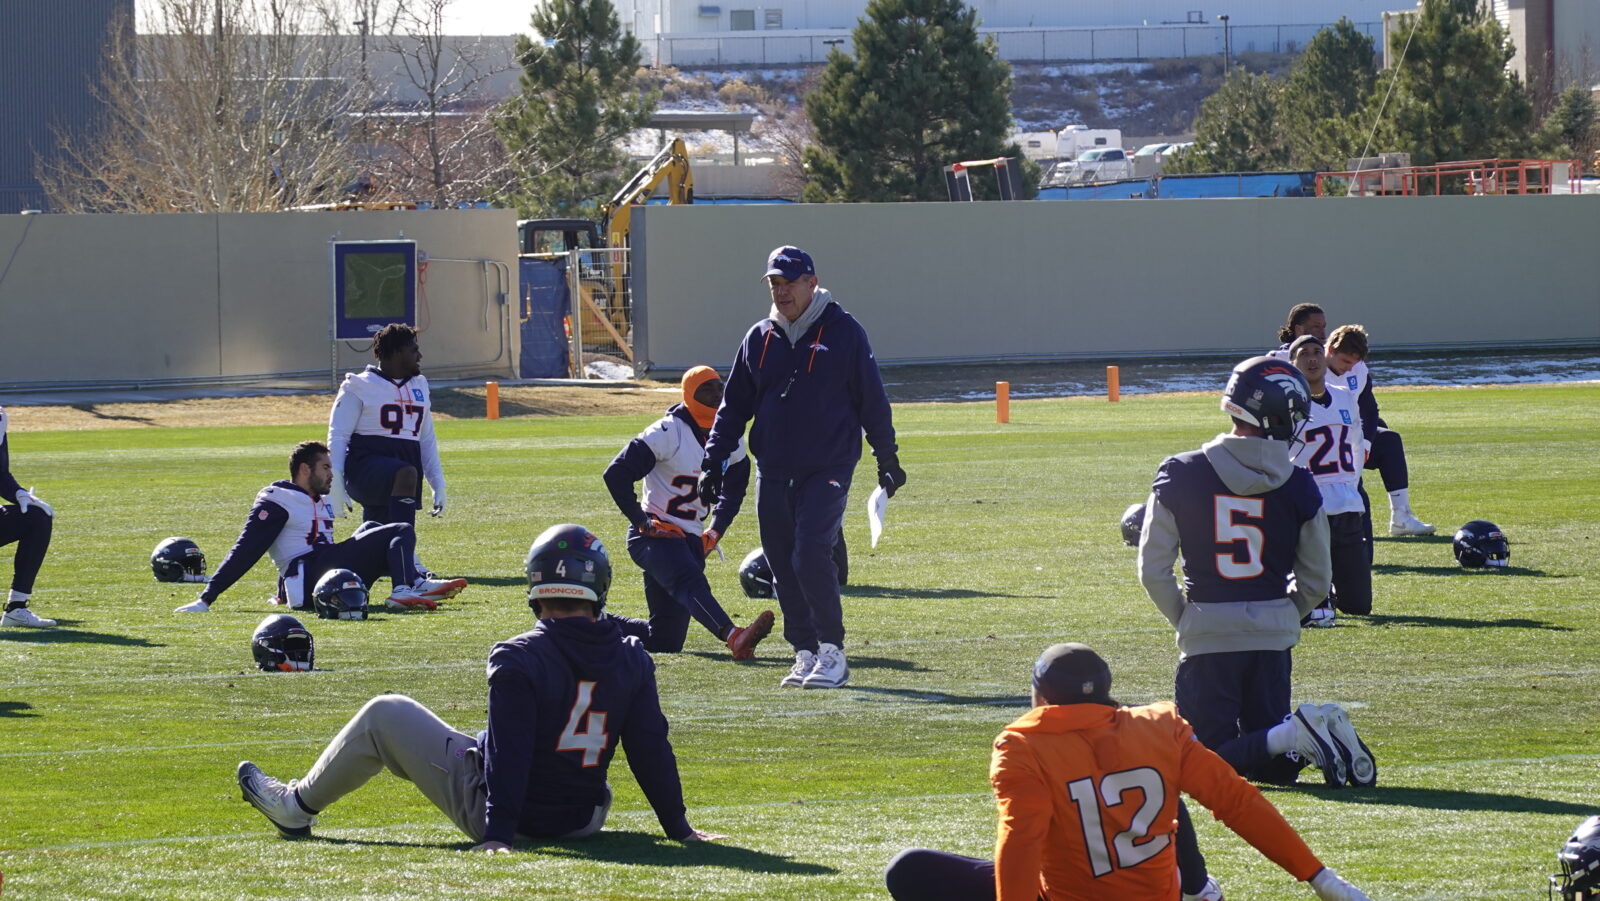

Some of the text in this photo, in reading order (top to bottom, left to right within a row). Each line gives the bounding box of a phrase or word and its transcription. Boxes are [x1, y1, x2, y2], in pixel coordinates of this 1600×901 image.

[380, 403, 425, 437] 97
[1305, 424, 1356, 476] 26
[1214, 494, 1265, 580] 5
[538, 587, 584, 596] BRONCOS
[555, 559, 566, 578] 4
[555, 680, 608, 768] 4
[1066, 765, 1172, 879] 12
